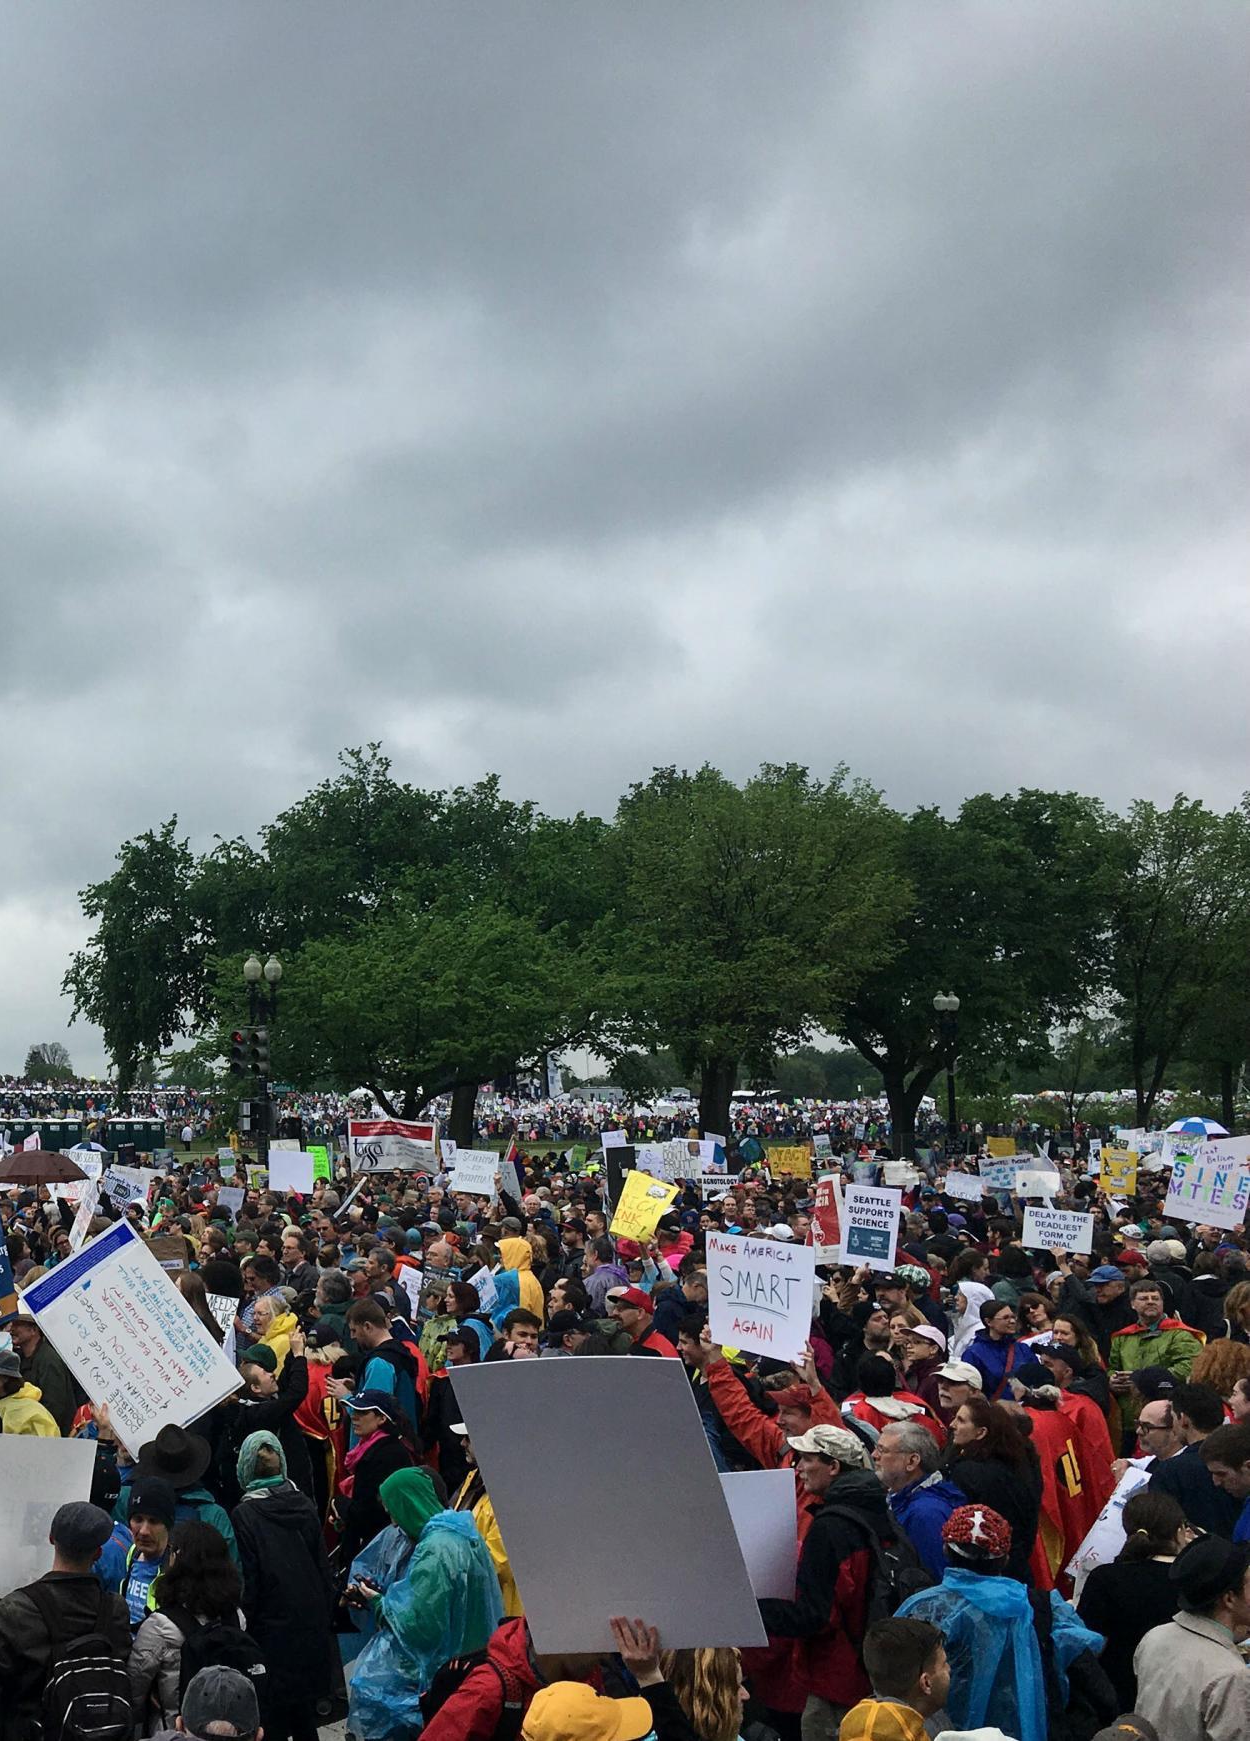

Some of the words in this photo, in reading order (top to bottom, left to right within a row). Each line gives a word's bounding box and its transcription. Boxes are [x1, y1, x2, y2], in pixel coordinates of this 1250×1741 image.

[848, 1206, 894, 1219] SUPPORTS
[853, 1195, 891, 1207] SEATTLE
[851, 1217, 889, 1229] SCIENCE
[1029, 1210, 1057, 1220] DELAY
[1072, 1215, 1088, 1224] THE
[1035, 1220, 1082, 1232] DEADLIEST
[1039, 1230, 1063, 1240] FORM
[1066, 1233, 1078, 1241] OF
[1041, 1239, 1073, 1250] DENIAL
[709, 1239, 737, 1254] MAKE
[743, 1242, 794, 1263] AMERICA
[720, 1265, 801, 1310] SMART
[123, 1300, 149, 1331] DOING
[733, 1317, 773, 1342] AGAIN
[88, 1339, 124, 1379] SCIENCE
[106, 1334, 163, 1404] EDUCATION
[150, 1357, 171, 1382] WILL
[167, 1358, 194, 1388] THAN
[104, 1393, 139, 1433] DOUBLE
